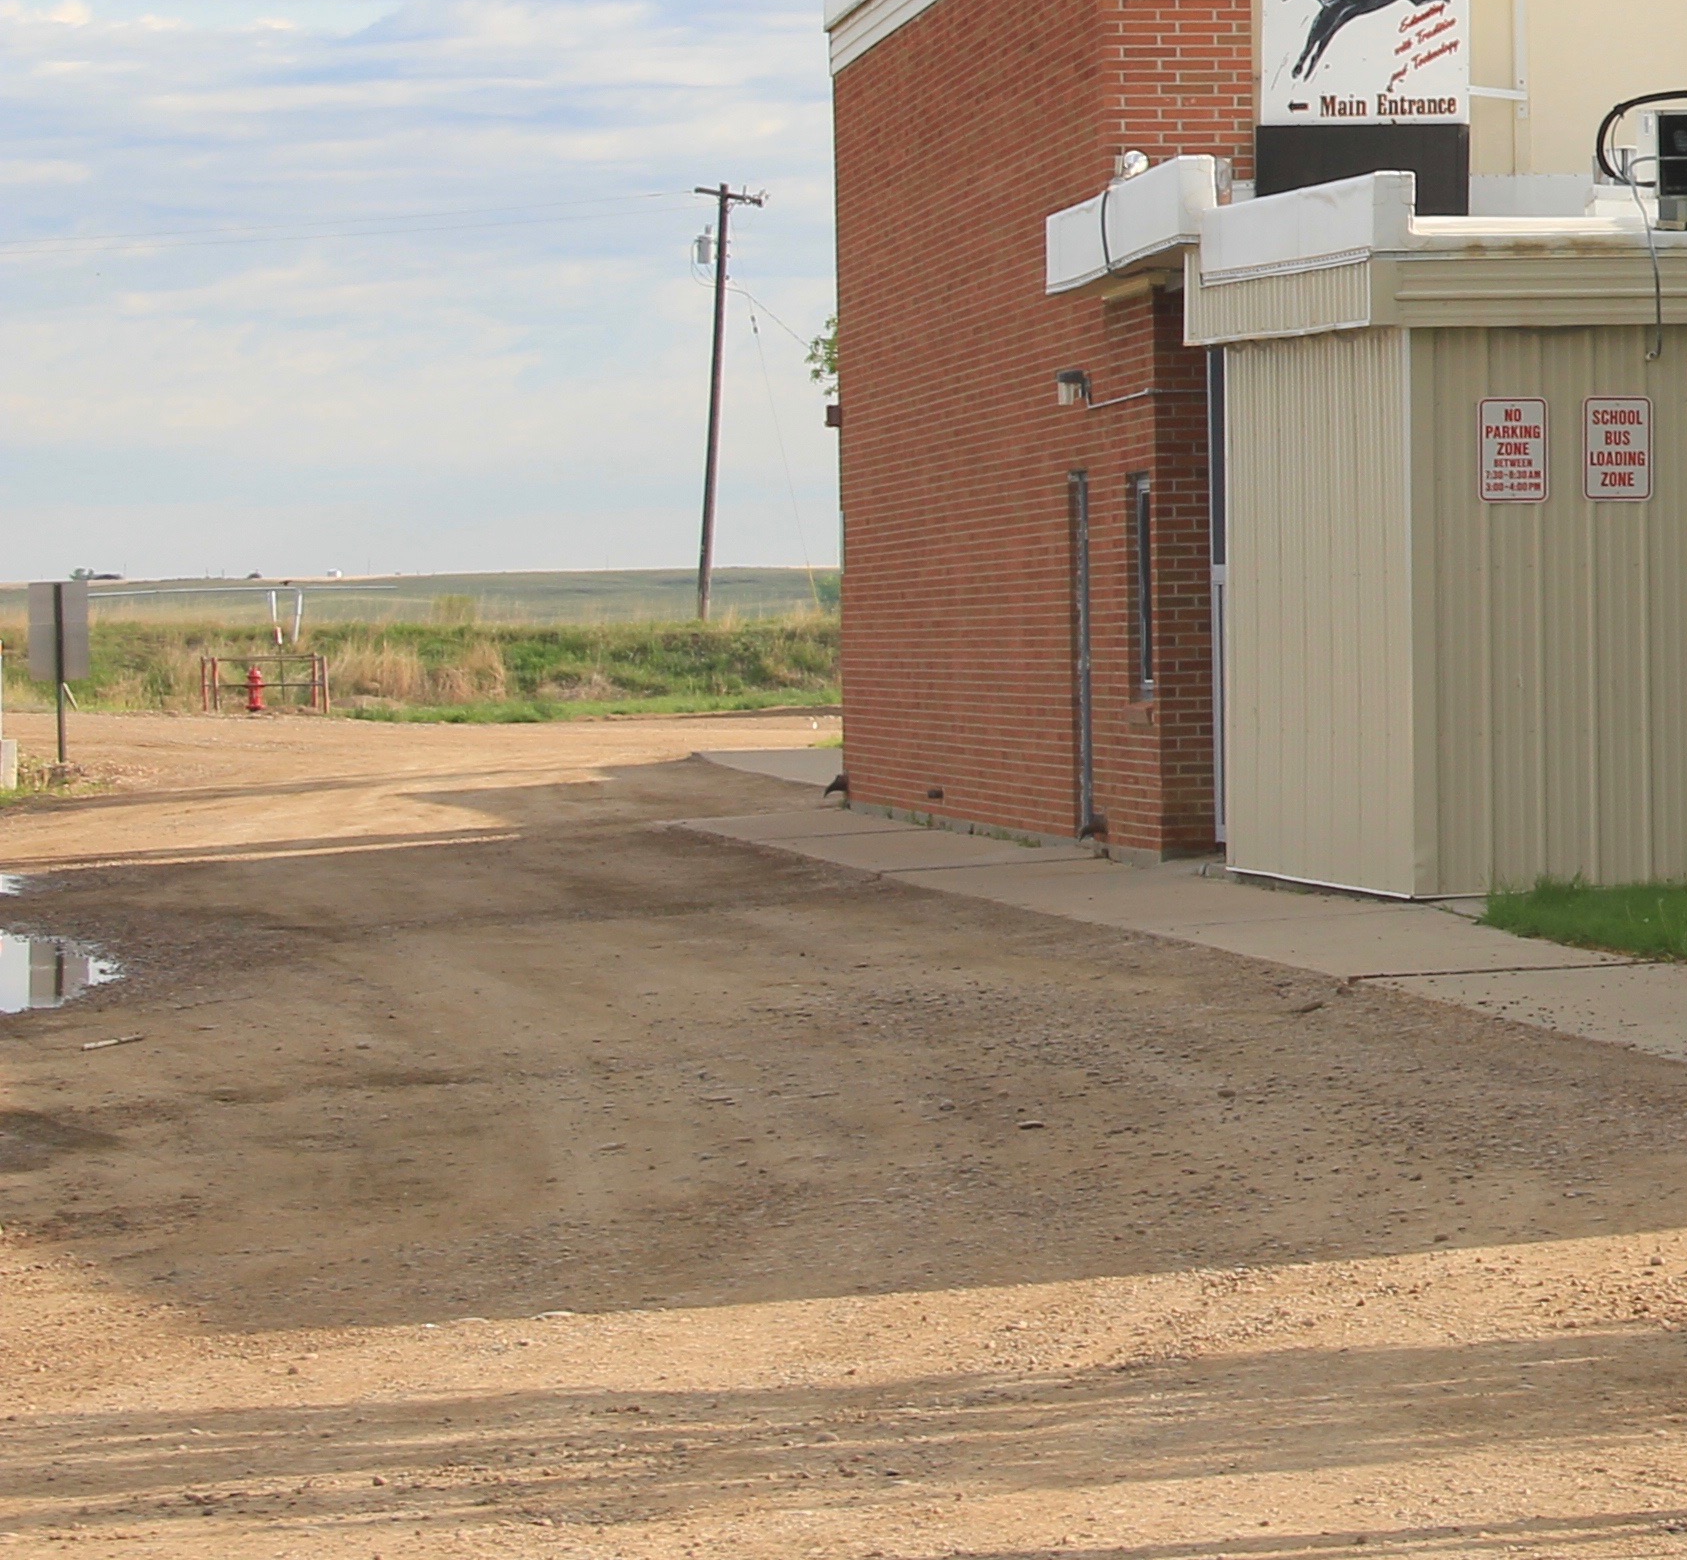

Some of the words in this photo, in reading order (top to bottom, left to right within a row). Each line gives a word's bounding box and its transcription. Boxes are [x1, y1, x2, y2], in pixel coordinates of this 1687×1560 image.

[1319, 95, 1367, 117] Main
[1376, 93, 1458, 116] Entrance
[1504, 409, 1522, 421] NO
[1592, 410, 1643, 425] SCHOOL
[1485, 425, 1541, 439] PARKING
[1604, 431, 1631, 446] BUS
[1497, 442, 1530, 456] ZONE
[1494, 459, 1533, 467] BETWEEN
[1590, 451, 1646, 466] LOADING
[1600, 472, 1635, 487] ZONE
